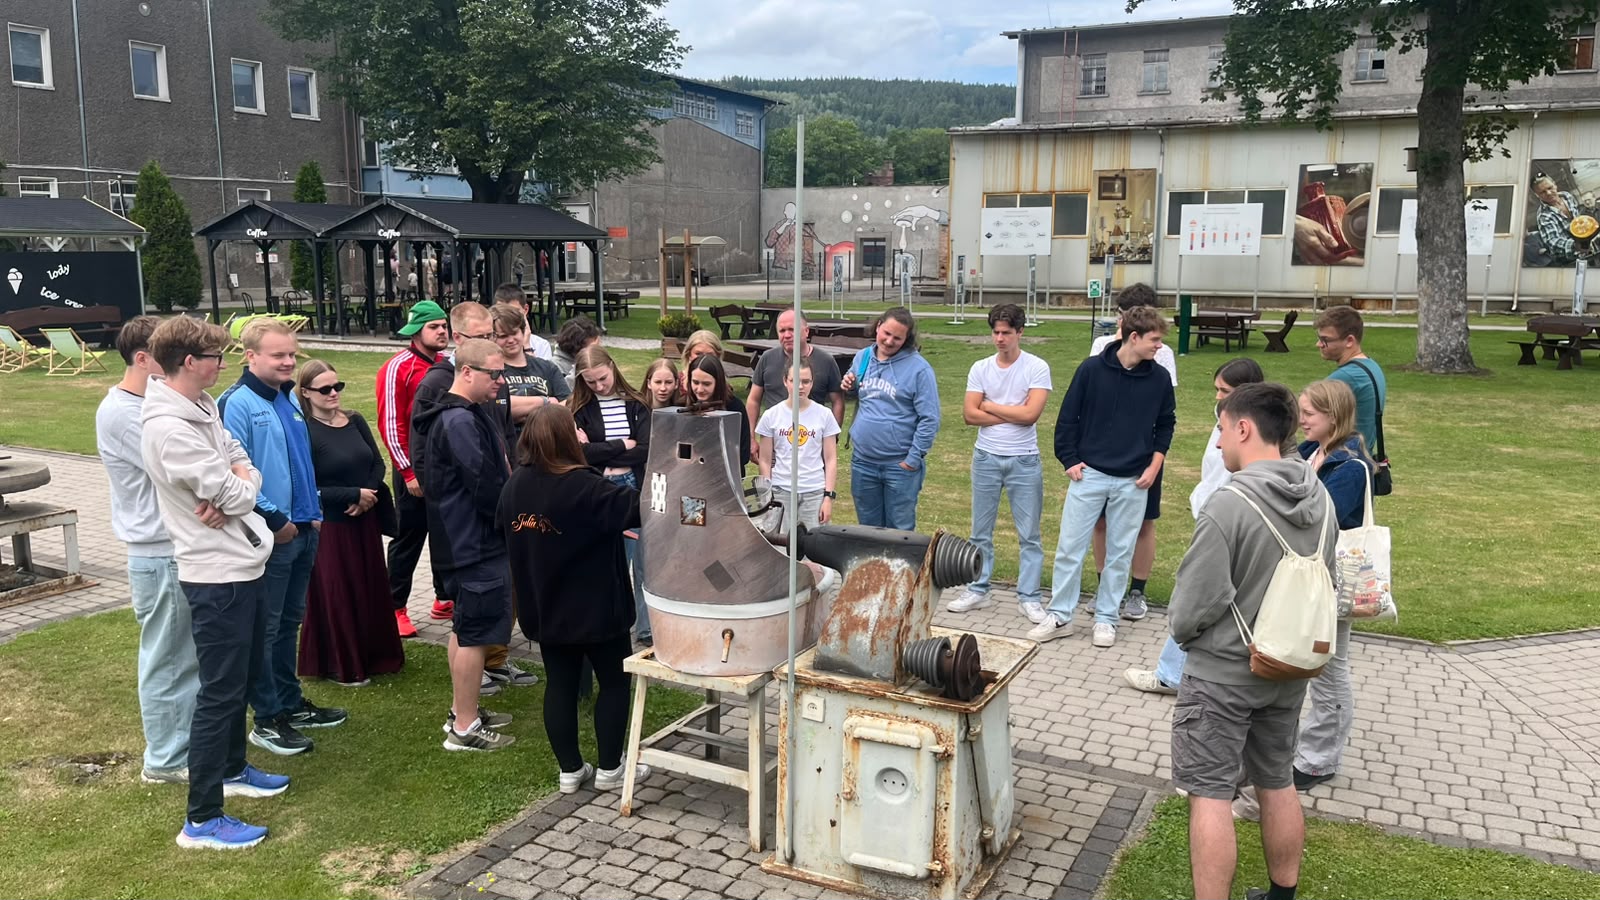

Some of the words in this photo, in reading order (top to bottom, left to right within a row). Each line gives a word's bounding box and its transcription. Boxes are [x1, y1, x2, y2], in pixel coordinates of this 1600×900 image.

[247, 228, 268, 238] Coffee
[378, 228, 401, 239] Coffee
[46, 264, 70, 280] lody
[64, 298, 86, 309] crea
[505, 375, 523, 384] ARD
[860, 377, 897, 400] PLORE
[798, 428, 816, 438] Rock
